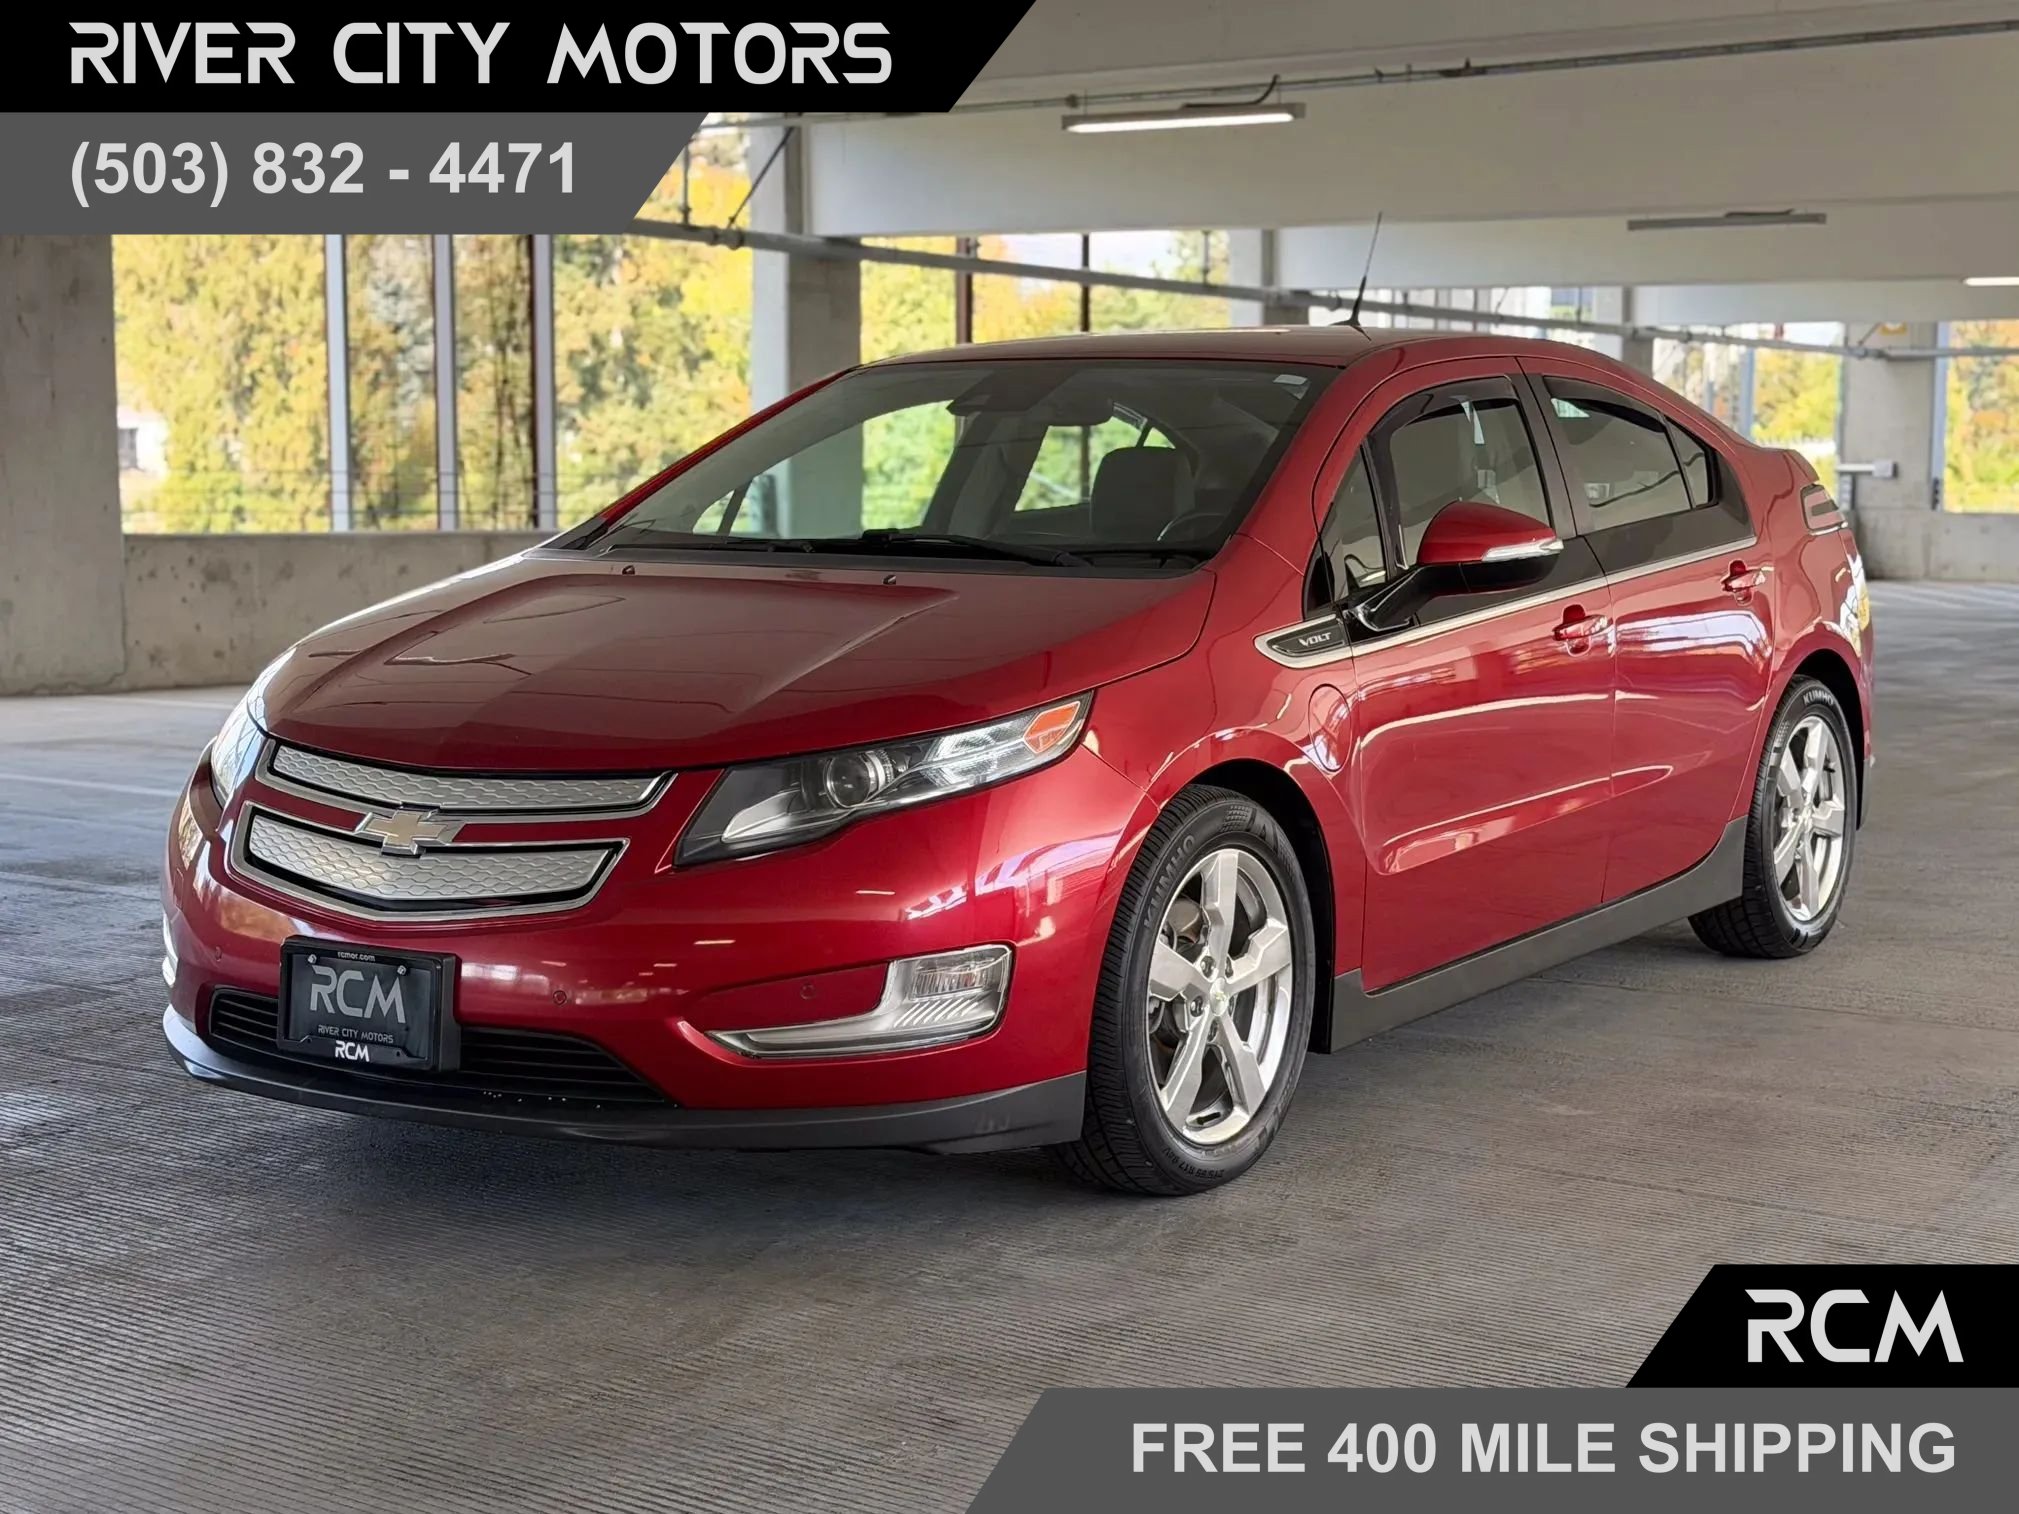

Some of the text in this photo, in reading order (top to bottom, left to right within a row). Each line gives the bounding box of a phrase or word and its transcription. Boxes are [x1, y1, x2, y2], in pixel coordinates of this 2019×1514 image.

[1298, 632, 1332, 647] VOLT
[1803, 689, 1834, 706] KUMHO
[1143, 834, 1196, 927] KUMHO
[309, 964, 407, 1024] RCM
[318, 1024, 394, 1044] RIVER CITY MOTORS
[335, 1039, 370, 1062] RCM
